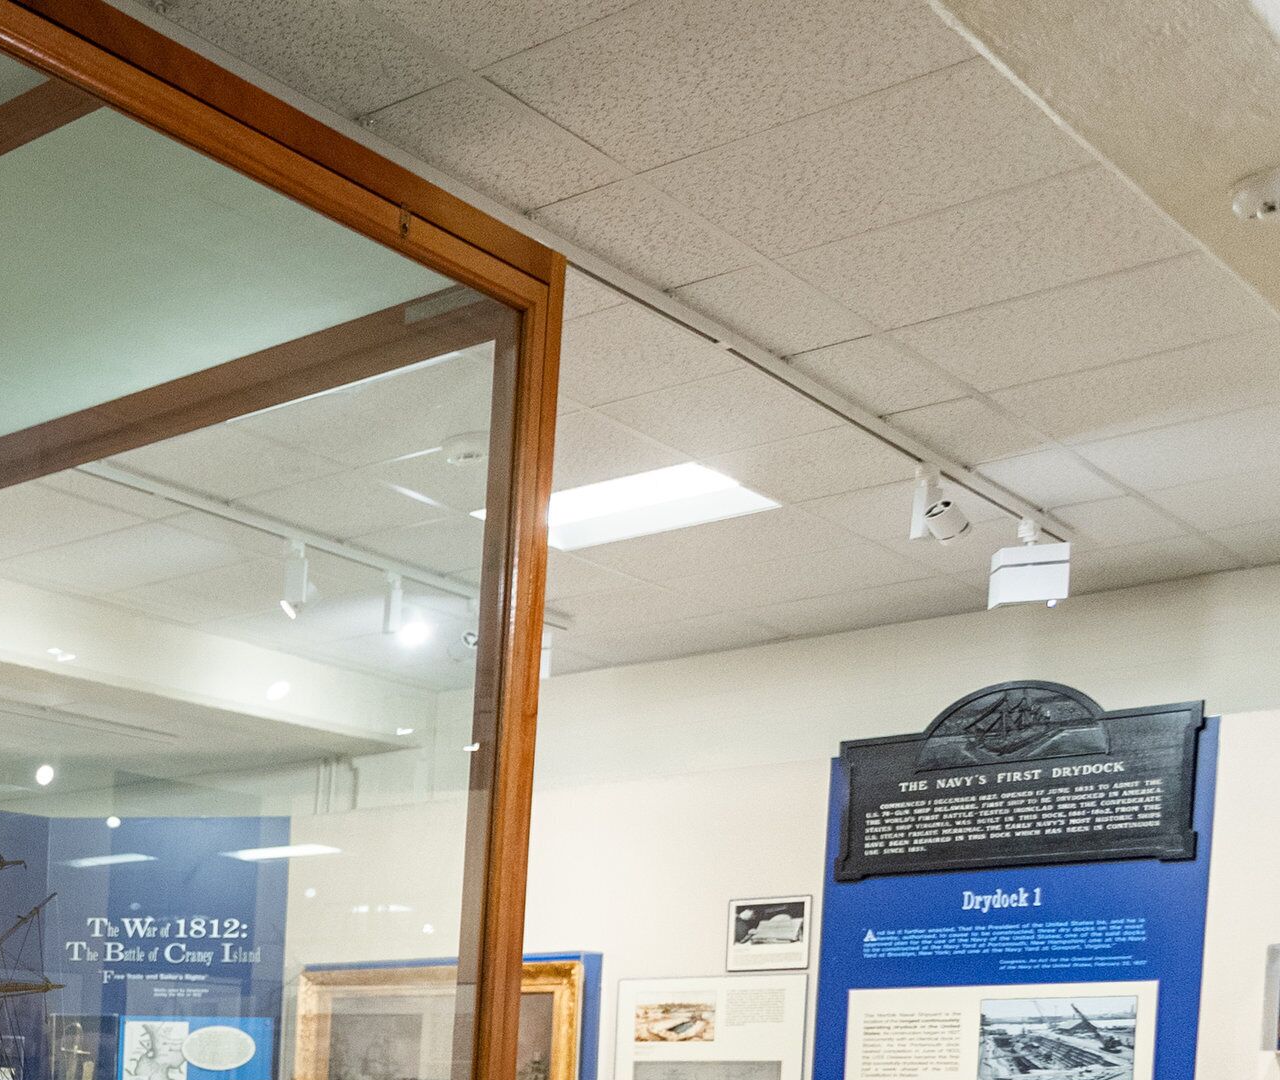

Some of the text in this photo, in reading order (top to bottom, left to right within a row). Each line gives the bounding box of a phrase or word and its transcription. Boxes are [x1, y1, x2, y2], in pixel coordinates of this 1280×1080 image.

[898, 761, 1125, 792] THE NAVY'S FIRST DRYDOCK
[961, 887, 1041, 914] Drydock 1
[87, 917, 248, 939] The War of 1812:
[65, 941, 261, 966] The Battle of Craney Island
